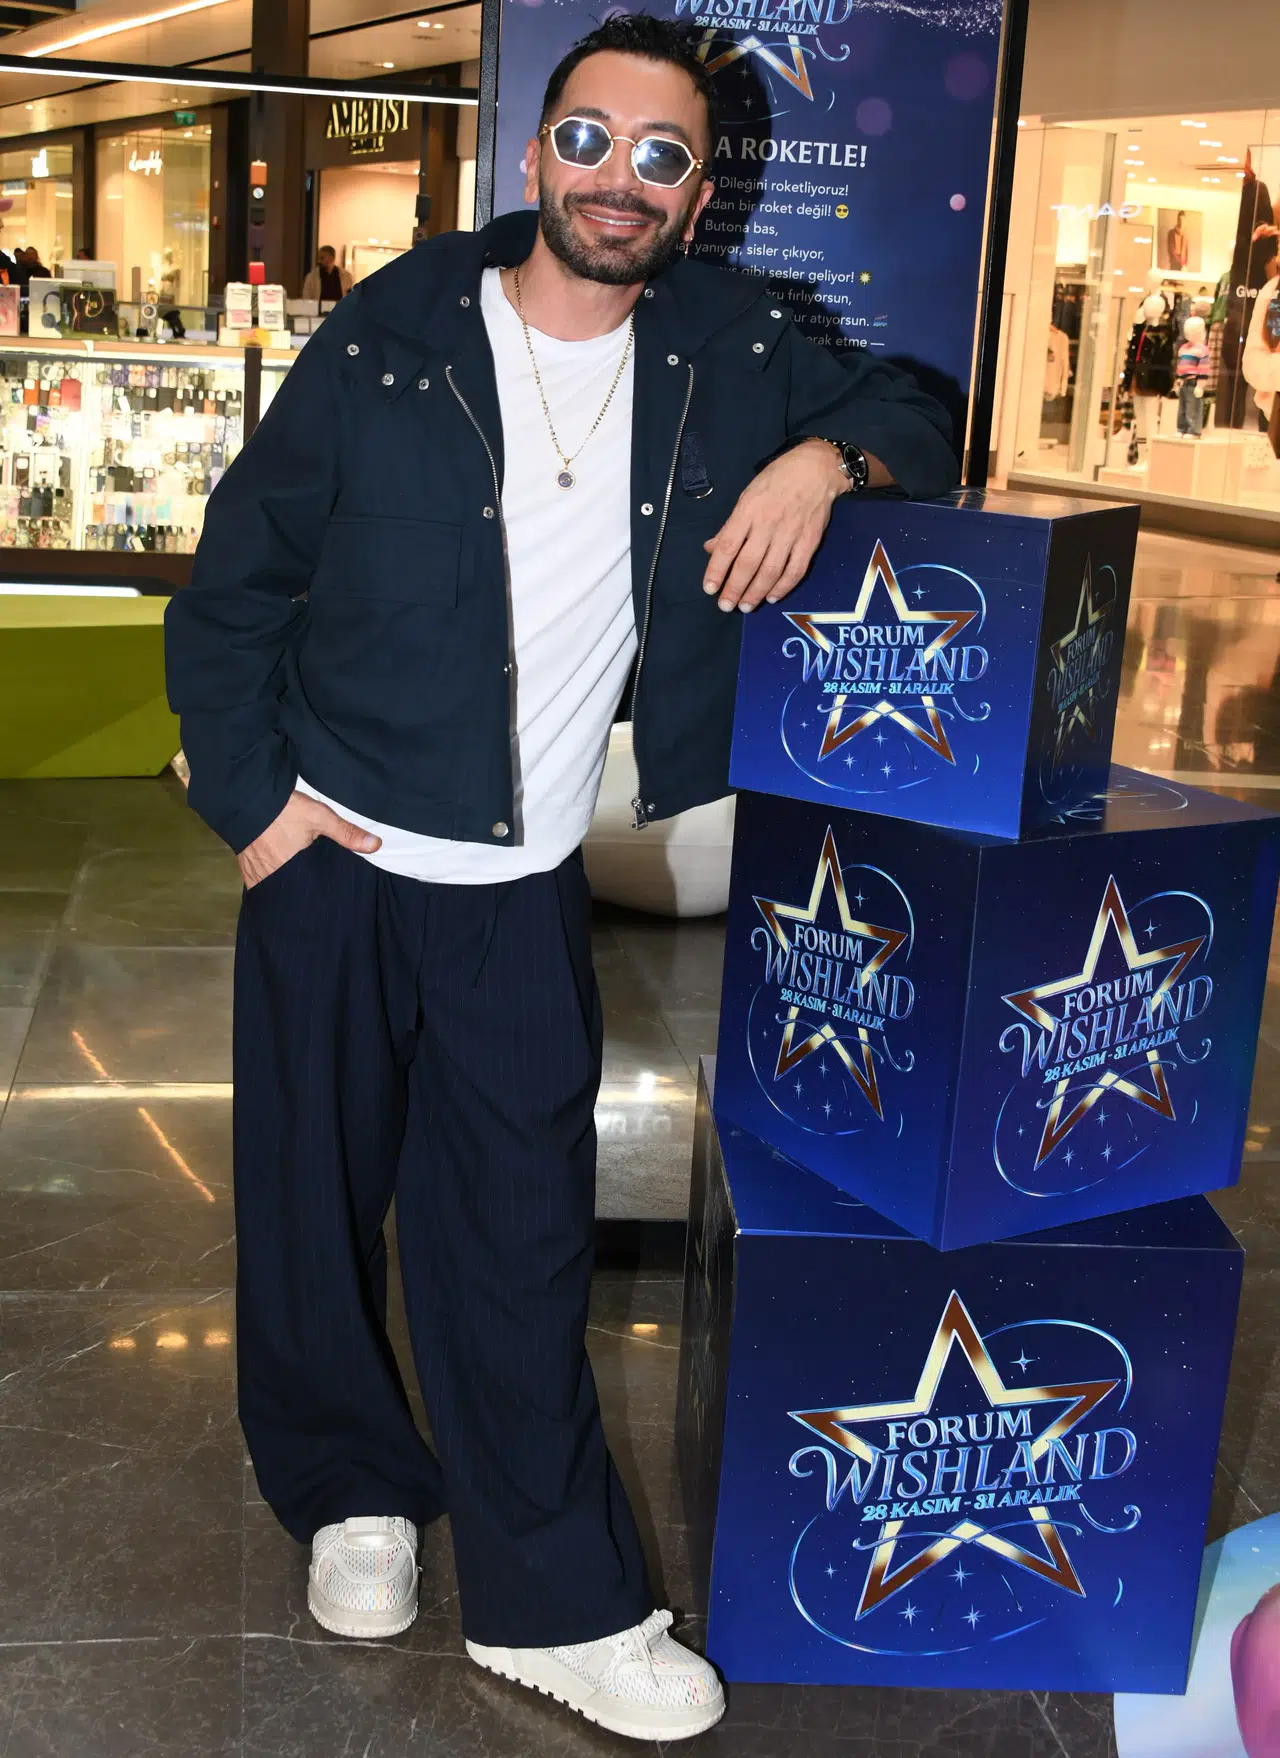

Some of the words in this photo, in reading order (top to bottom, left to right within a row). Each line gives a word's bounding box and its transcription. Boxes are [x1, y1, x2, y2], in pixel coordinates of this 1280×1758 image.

[694, 16, 708, 27] 28
[710, 17, 751, 31] KASIM
[757, 20, 770, 32] 31
[770, 22, 819, 36] ARALIK
[741, 137, 868, 168] ROKETLE!
[719, 176, 768, 193] Dileğini
[771, 180, 849, 197] roketliyoruz!
[704, 198, 735, 211] adan
[739, 199, 756, 212] bir
[759, 201, 793, 215] roket
[796, 203, 831, 219] değil!
[705, 219, 750, 234] Butona
[753, 221, 779, 237] bas,
[694, 243, 743, 257] yanıyor,
[746, 244, 779, 258] sisler
[782, 247, 825, 262] çıkıyor,
[768, 267, 804, 281] sesler
[808, 271, 855, 285] geliyor!
[788, 289, 852, 306] fırlıyorsun,
[809, 314, 870, 328] atıyorsun.
[835, 337, 869, 348] etme
[837, 625, 925, 646] FORUM
[1066, 626, 1097, 665] FORUM
[781, 637, 989, 683] WISHLAND
[822, 682, 838, 694] 28
[838, 682, 881, 694] KASIM
[888, 682, 902, 695] 31
[902, 682, 955, 695] ARALIK
[794, 923, 864, 964] FORUM
[751, 927, 915, 1020] WISHLAND
[780, 987, 793, 1003] 28
[793, 993, 828, 1014] KASIM
[831, 1003, 843, 1019] 31
[843, 1006, 886, 1032] ARALIK
[1062, 968, 1154, 1021] FORUM
[999, 975, 1213, 1079] WISHLAND
[1043, 1068, 1060, 1084] 28
[1060, 1053, 1106, 1079] KASIM
[1114, 1045, 1127, 1061] 31
[1127, 1027, 1181, 1056] ARALIK
[886, 1408, 1033, 1451] FORUM
[788, 1427, 1137, 1512] WISHLAND
[861, 1503, 888, 1522] 28
[889, 1499, 960, 1519] KASIM
[973, 1492, 996, 1509] 31
[996, 1484, 1083, 1509] ARALIK
